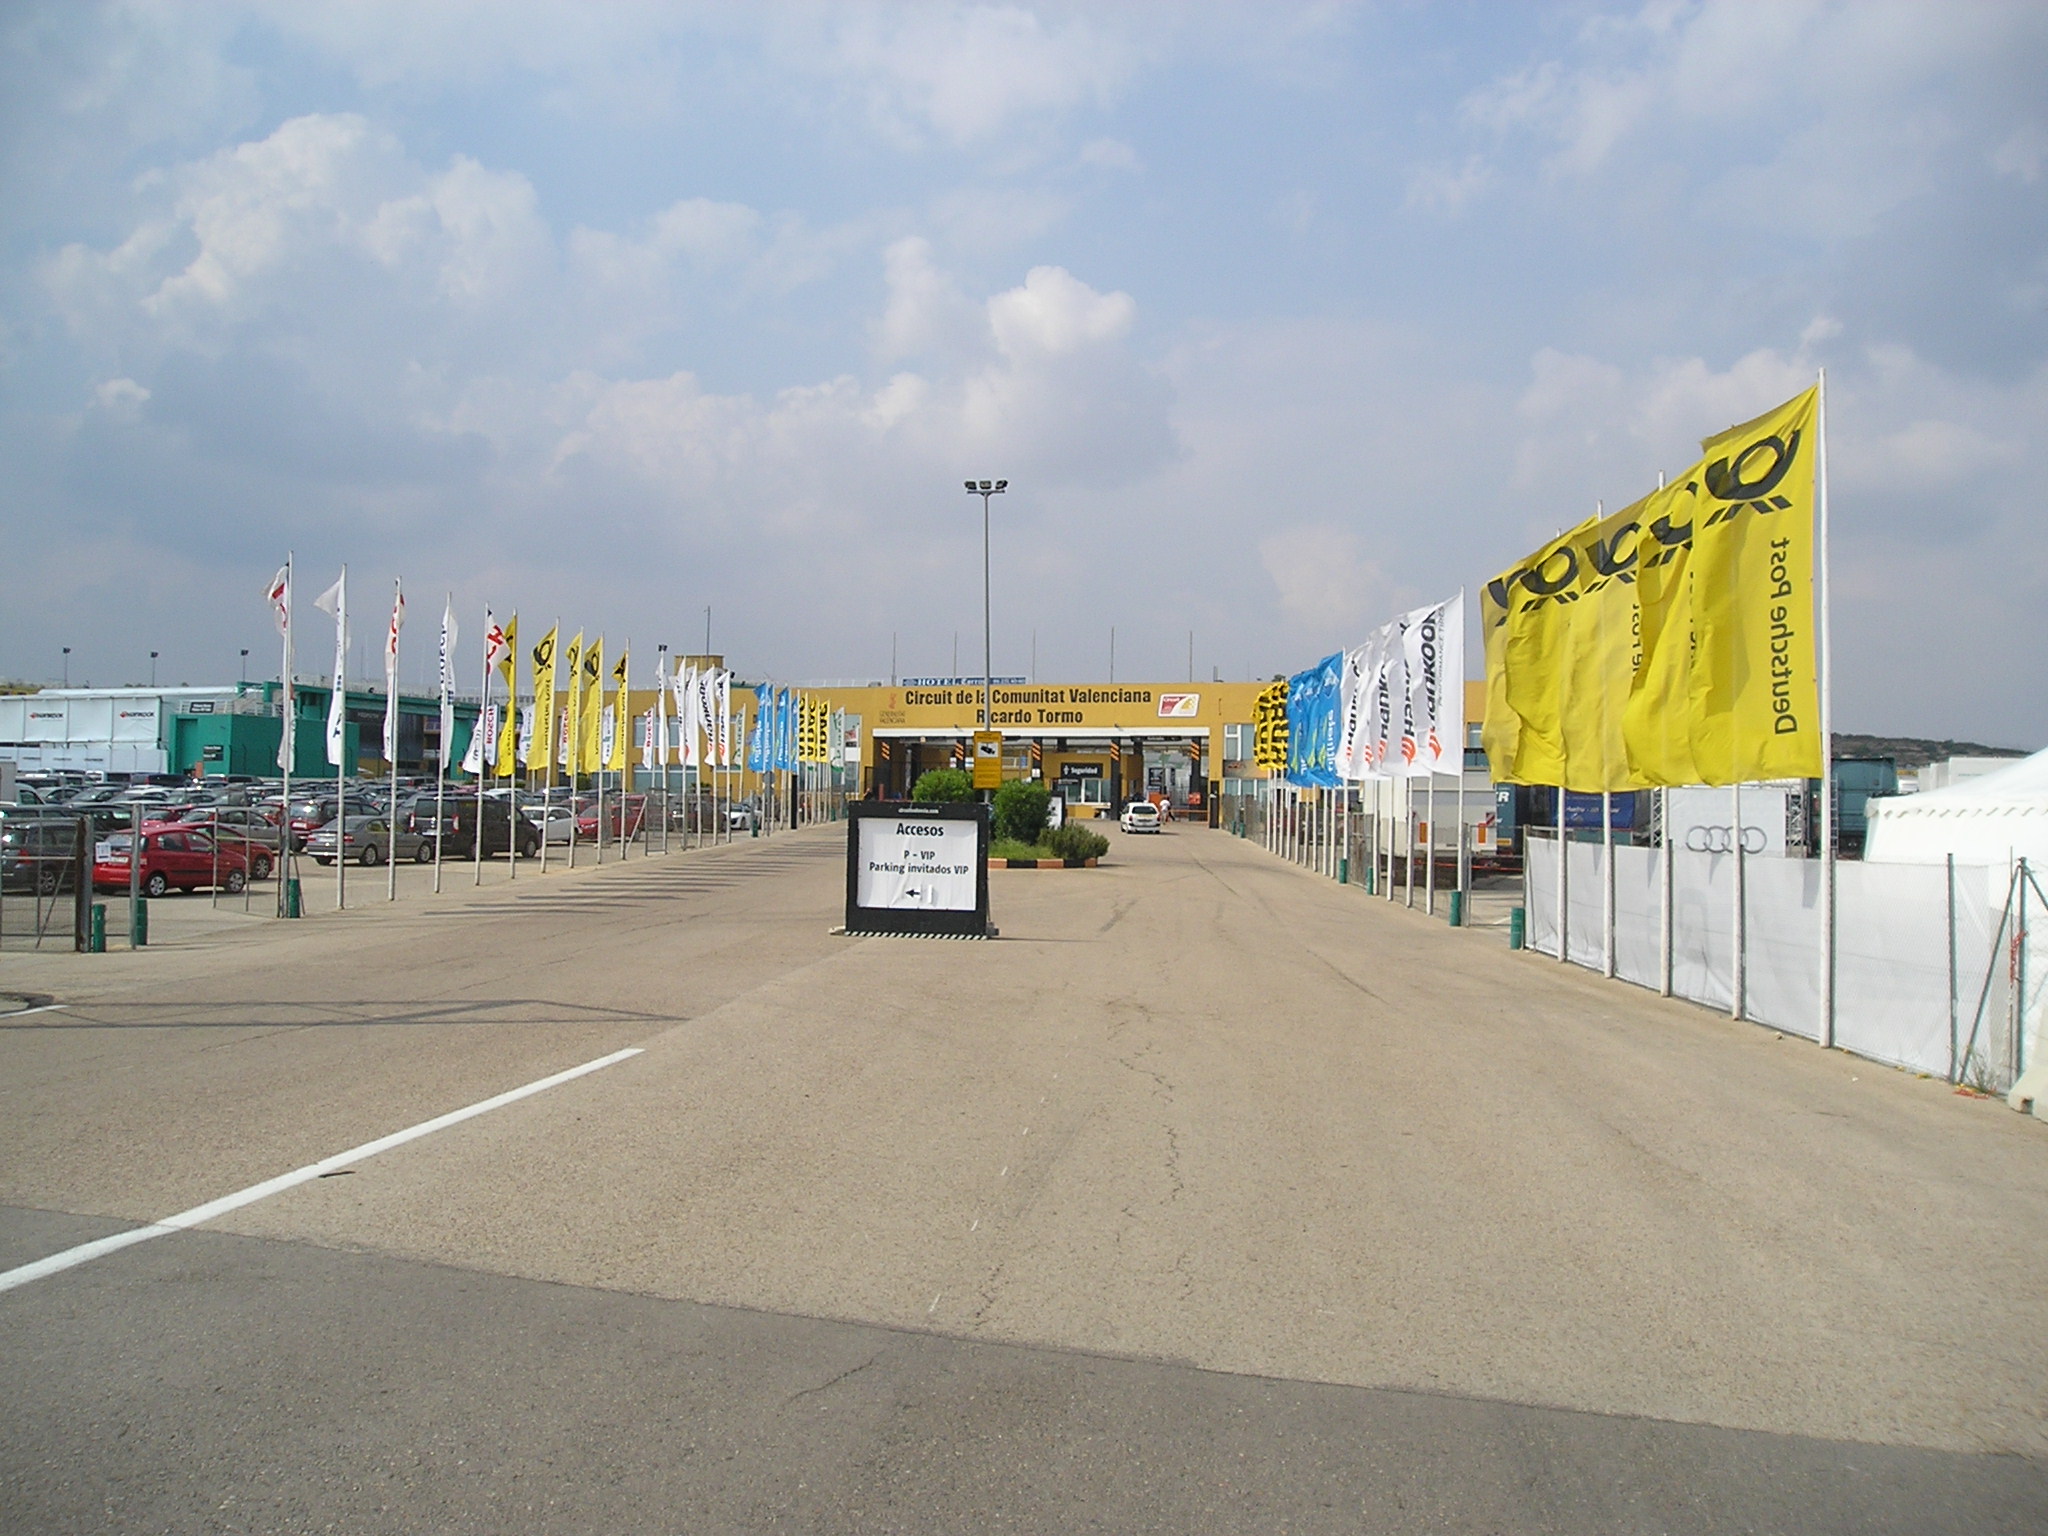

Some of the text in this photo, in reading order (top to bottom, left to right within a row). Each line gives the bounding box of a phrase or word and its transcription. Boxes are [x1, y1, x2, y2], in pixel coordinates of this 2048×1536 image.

[905, 690, 953, 705] Circuit
[956, 689, 973, 704] de
[992, 688, 1065, 704] Comunitat
[1069, 687, 1151, 703] Valenciana
[976, 708, 1083, 723] Rcardo Tormo
[1071, 766, 1098, 775] Seguridad
[896, 822, 944, 836] Accesos
[904, 850, 910, 859] P
[920, 850, 936, 860] VIP
[869, 862, 969, 875] Parking invitados VIP
